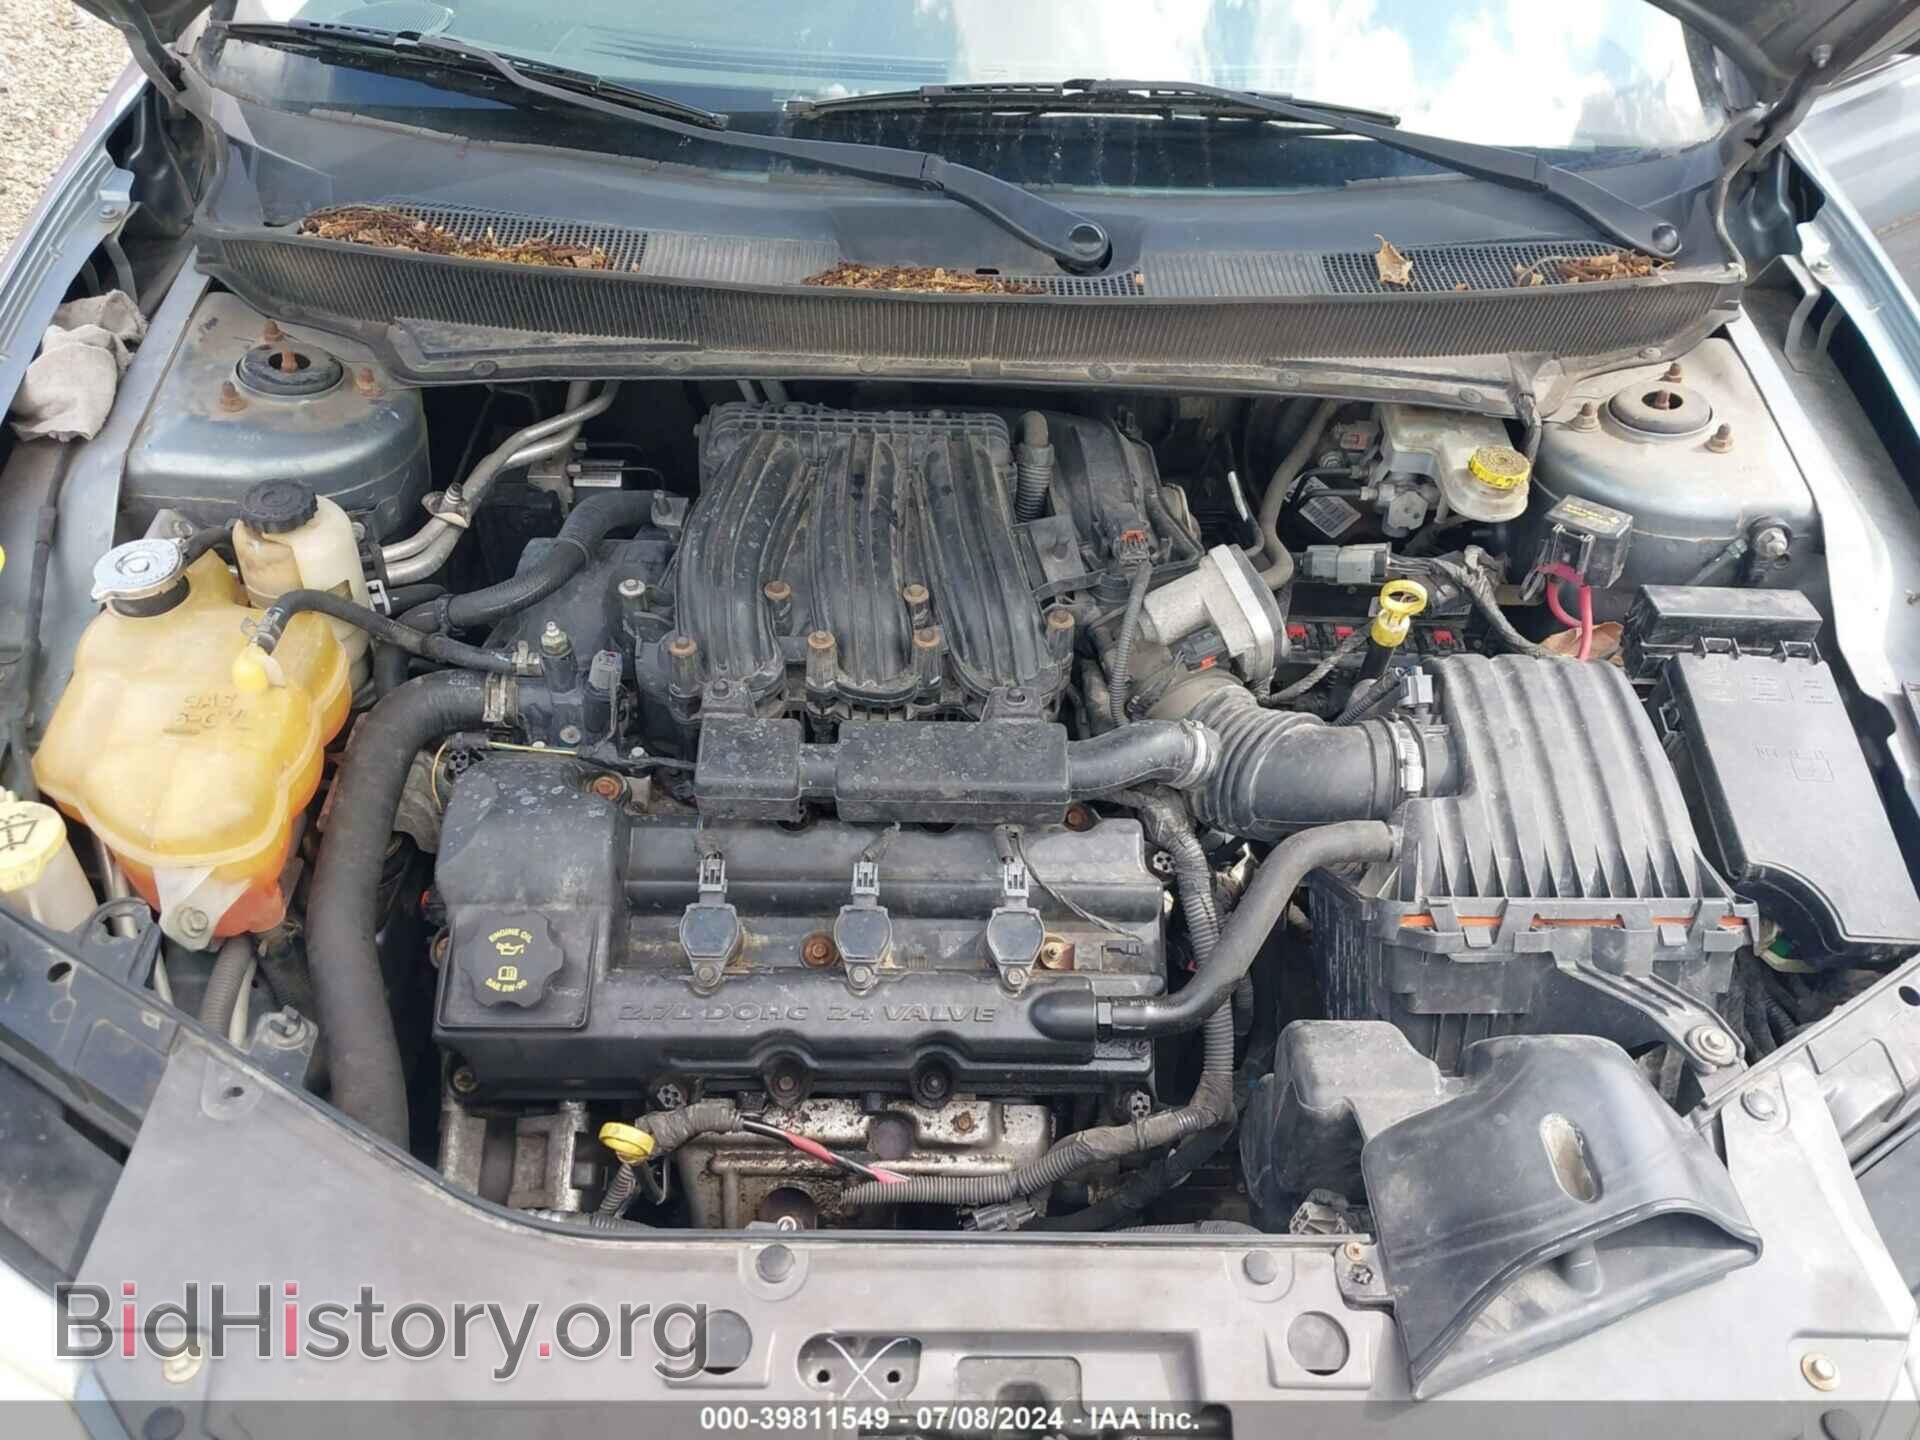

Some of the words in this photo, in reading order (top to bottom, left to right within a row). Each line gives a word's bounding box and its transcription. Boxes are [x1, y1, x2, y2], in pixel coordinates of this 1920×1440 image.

[488, 928, 521, 943] ENGINE
[520, 931, 533, 944] OIL
[617, 1002, 693, 1021] 2.7L
[704, 1002, 808, 1021] DOHC
[826, 1002, 874, 1021] 24
[883, 1003, 998, 1022] VALVE
